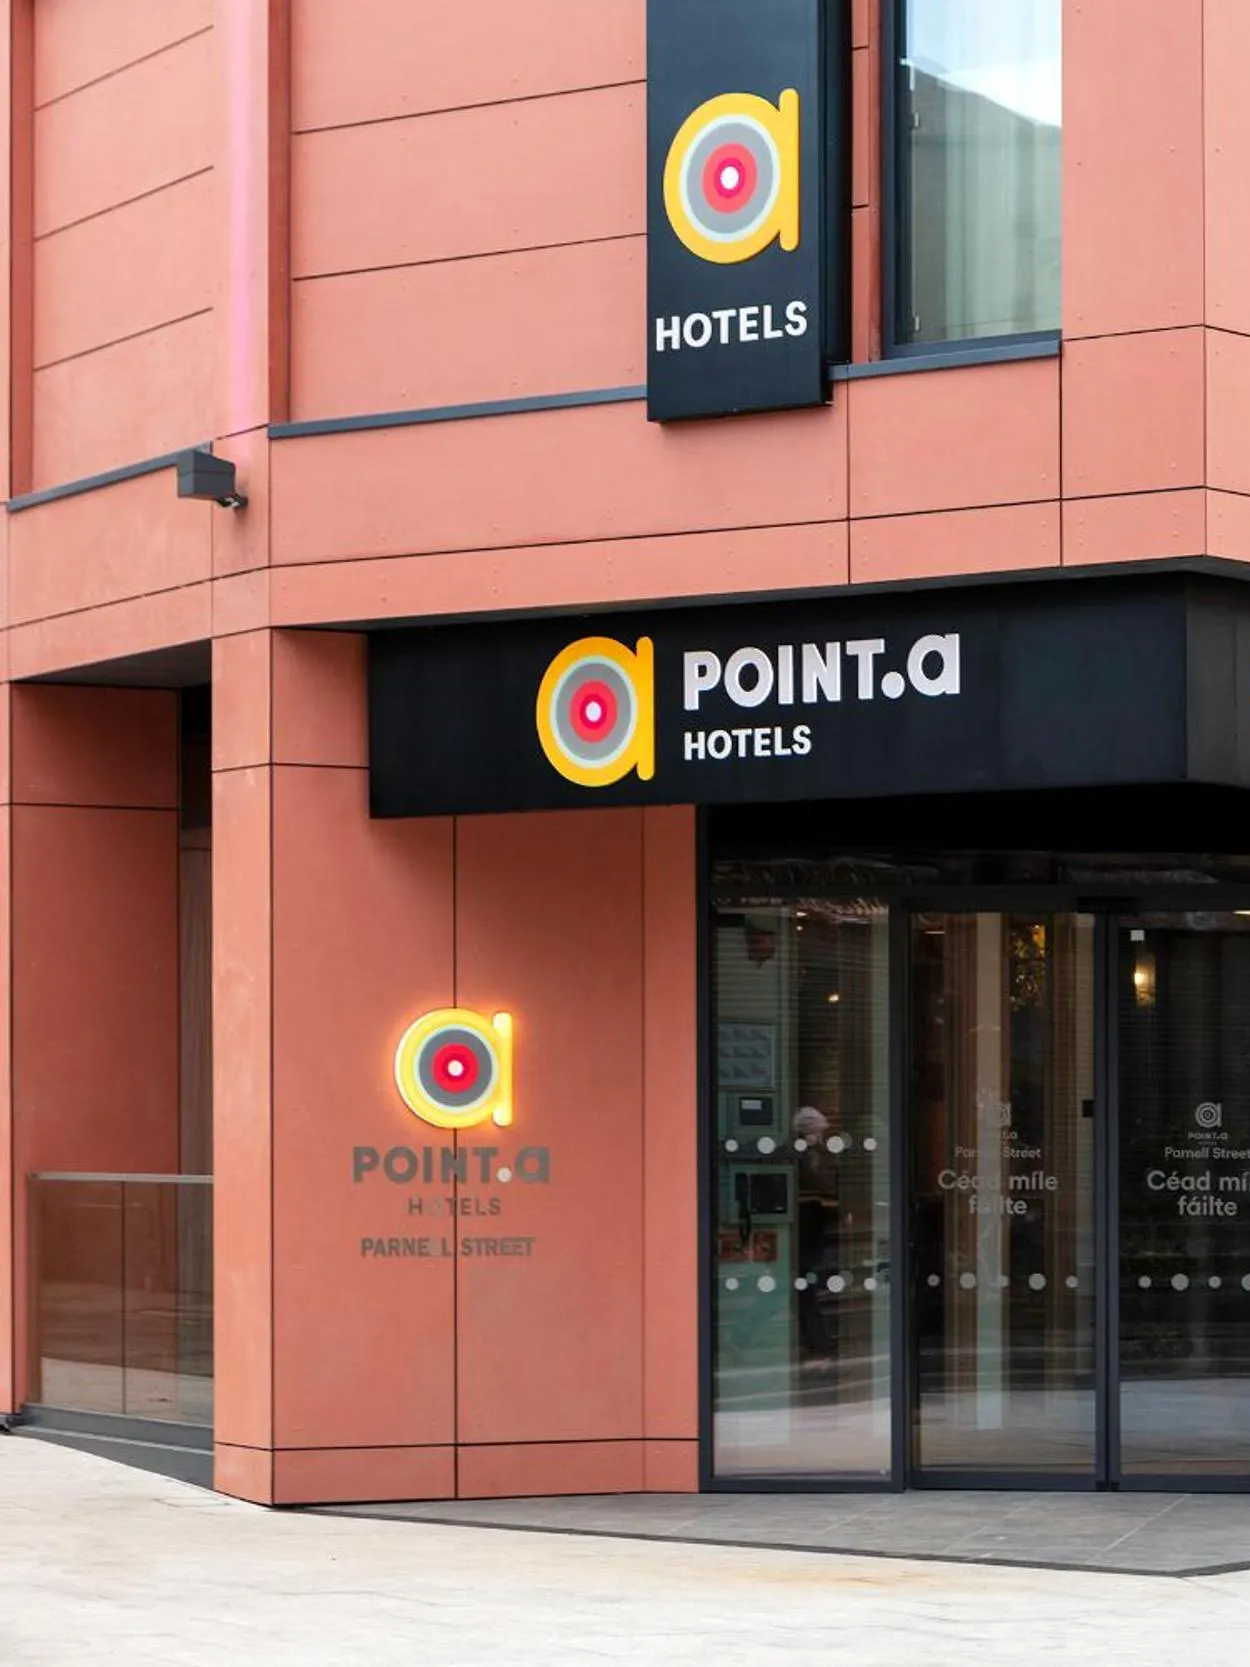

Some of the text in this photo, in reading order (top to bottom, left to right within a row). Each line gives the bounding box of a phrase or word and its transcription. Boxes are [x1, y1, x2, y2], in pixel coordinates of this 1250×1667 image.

[656, 300, 808, 352] HOTELS
[683, 633, 961, 710] POINT.a
[684, 725, 812, 760] HOTELS
[352, 1146, 550, 1183] POINT.a
[1147, 1169, 1211, 1191] Céad
[1177, 1195, 1238, 1217] fáilte
[360, 1237, 535, 1257] PARNEL STREET
